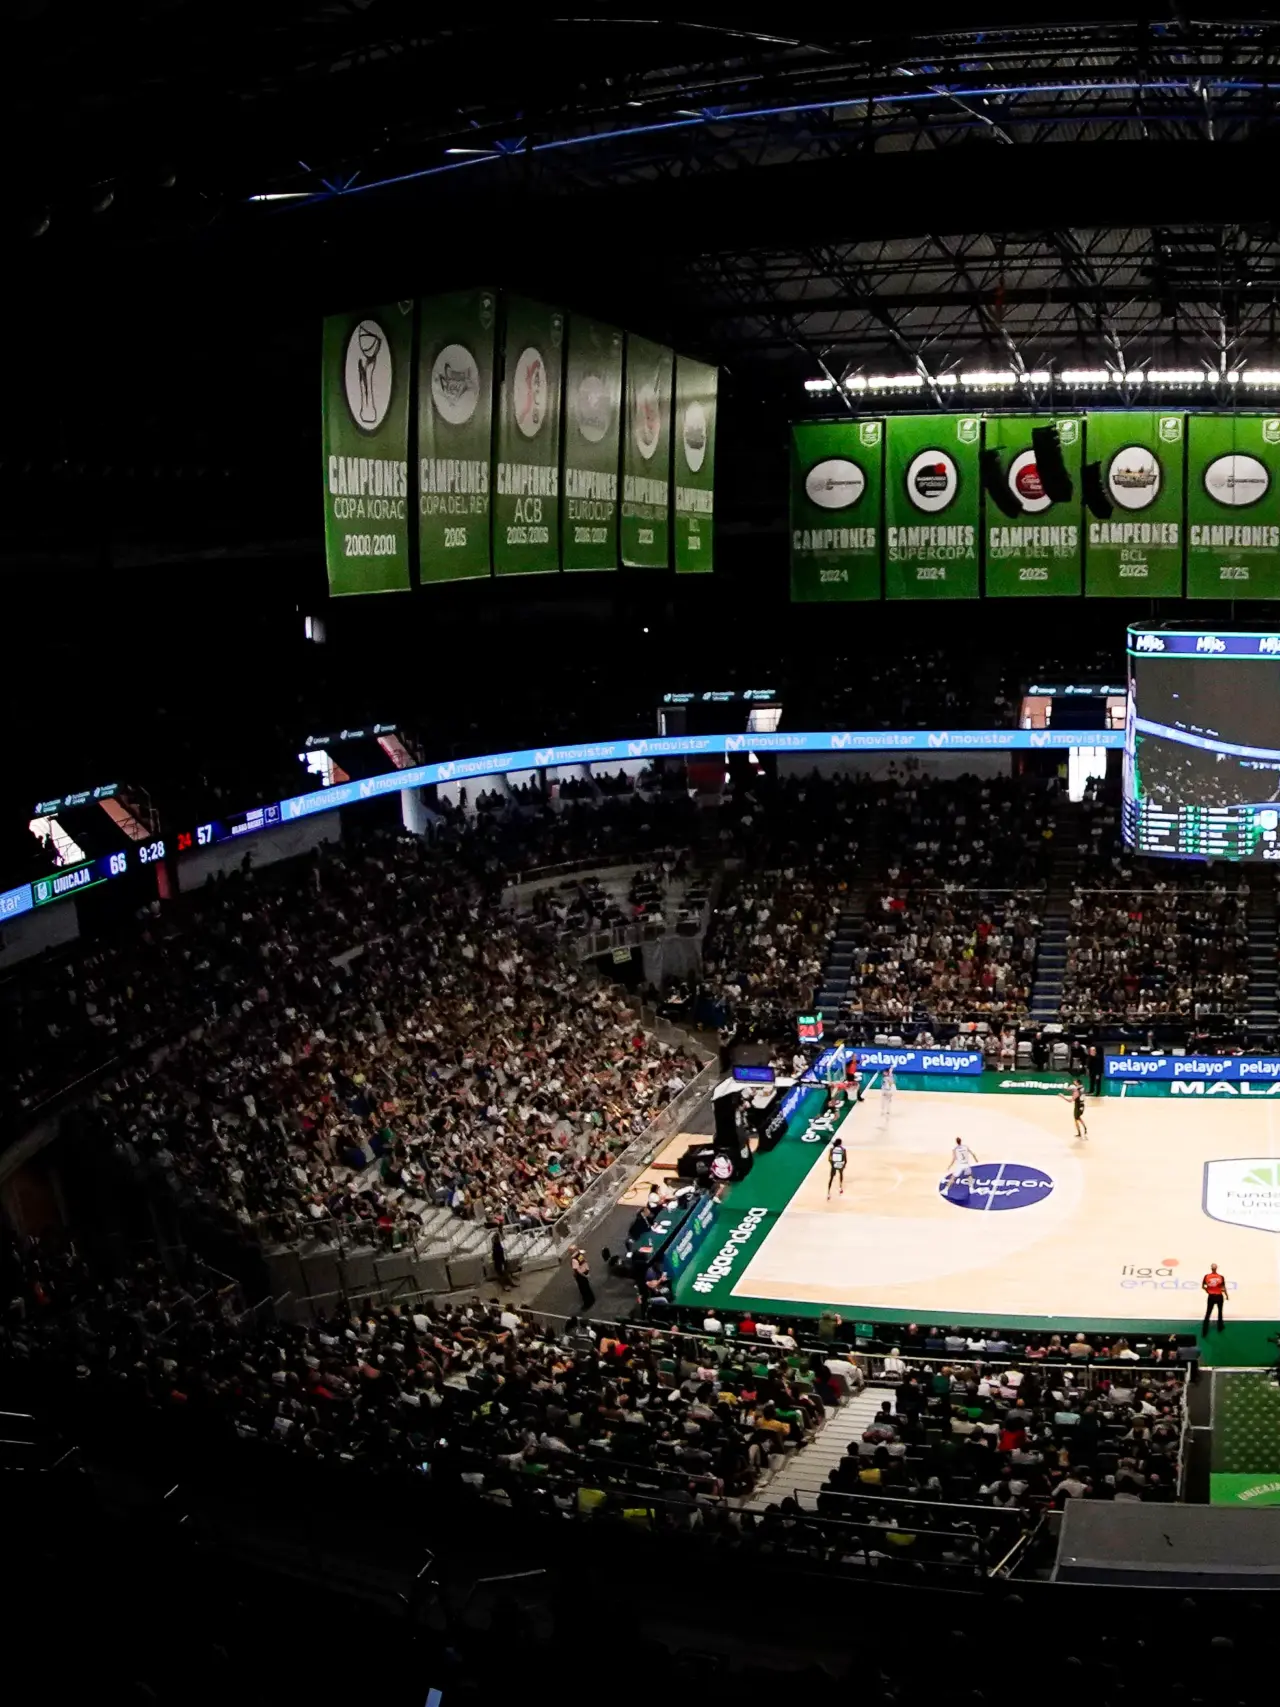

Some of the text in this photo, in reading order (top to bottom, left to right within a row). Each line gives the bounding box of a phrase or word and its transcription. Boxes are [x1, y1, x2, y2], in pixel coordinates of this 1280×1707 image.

[329, 455, 407, 497] CAMPEONES
[420, 458, 488, 493] CAMPEONES
[497, 463, 557, 496] CAMPEONES
[334, 498, 365, 518] COPA
[420, 496, 489, 515] COPA DEL REY
[514, 498, 542, 522] ACB
[568, 500, 614, 520] EUROCUP
[793, 528, 876, 549] CAMPEONES
[887, 526, 974, 547] CAMPEONES
[990, 526, 1078, 548] CAMPEONES
[1090, 523, 1178, 544] CAMPEONES
[1191, 525, 1279, 546] CAMPEONES
[345, 534, 396, 556] 2000/2001
[888, 547, 975, 561] SUPERCOPA
[990, 548, 1021, 559] COPA
[1026, 548, 1048, 558] DEL
[1121, 550, 1146, 561] BCL
[820, 569, 848, 582] 2024
[916, 568, 946, 580] 2024
[1020, 568, 1048, 580] 2025
[1119, 564, 1148, 577] 2025
[1220, 567, 1249, 579] 2025
[650, 738, 710, 751] movistar
[746, 736, 807, 748] movistar
[852, 734, 915, 745] movistar
[950, 734, 1014, 744] movistar
[1052, 733, 1117, 743] movistar
[555, 744, 615, 760] movistar
[455, 756, 513, 772] movistar
[374, 771, 425, 789] movistar
[305, 788, 350, 808] movistar
[177, 832, 192, 850] 24
[197, 824, 212, 845] 57
[139, 841, 165, 863] 9:28
[110, 853, 126, 875] 66
[53, 868, 91, 893] UNICAJA
[861, 1052, 908, 1068] pelayo
[922, 1054, 970, 1070] pelayo
[1109, 1059, 1158, 1075] pelayo
[1174, 1060, 1223, 1076] pelayo
[692, 1207, 768, 1293] #ligaendesa
[1122, 1264, 1173, 1278] liga
[1120, 1278, 1237, 1290] endea
